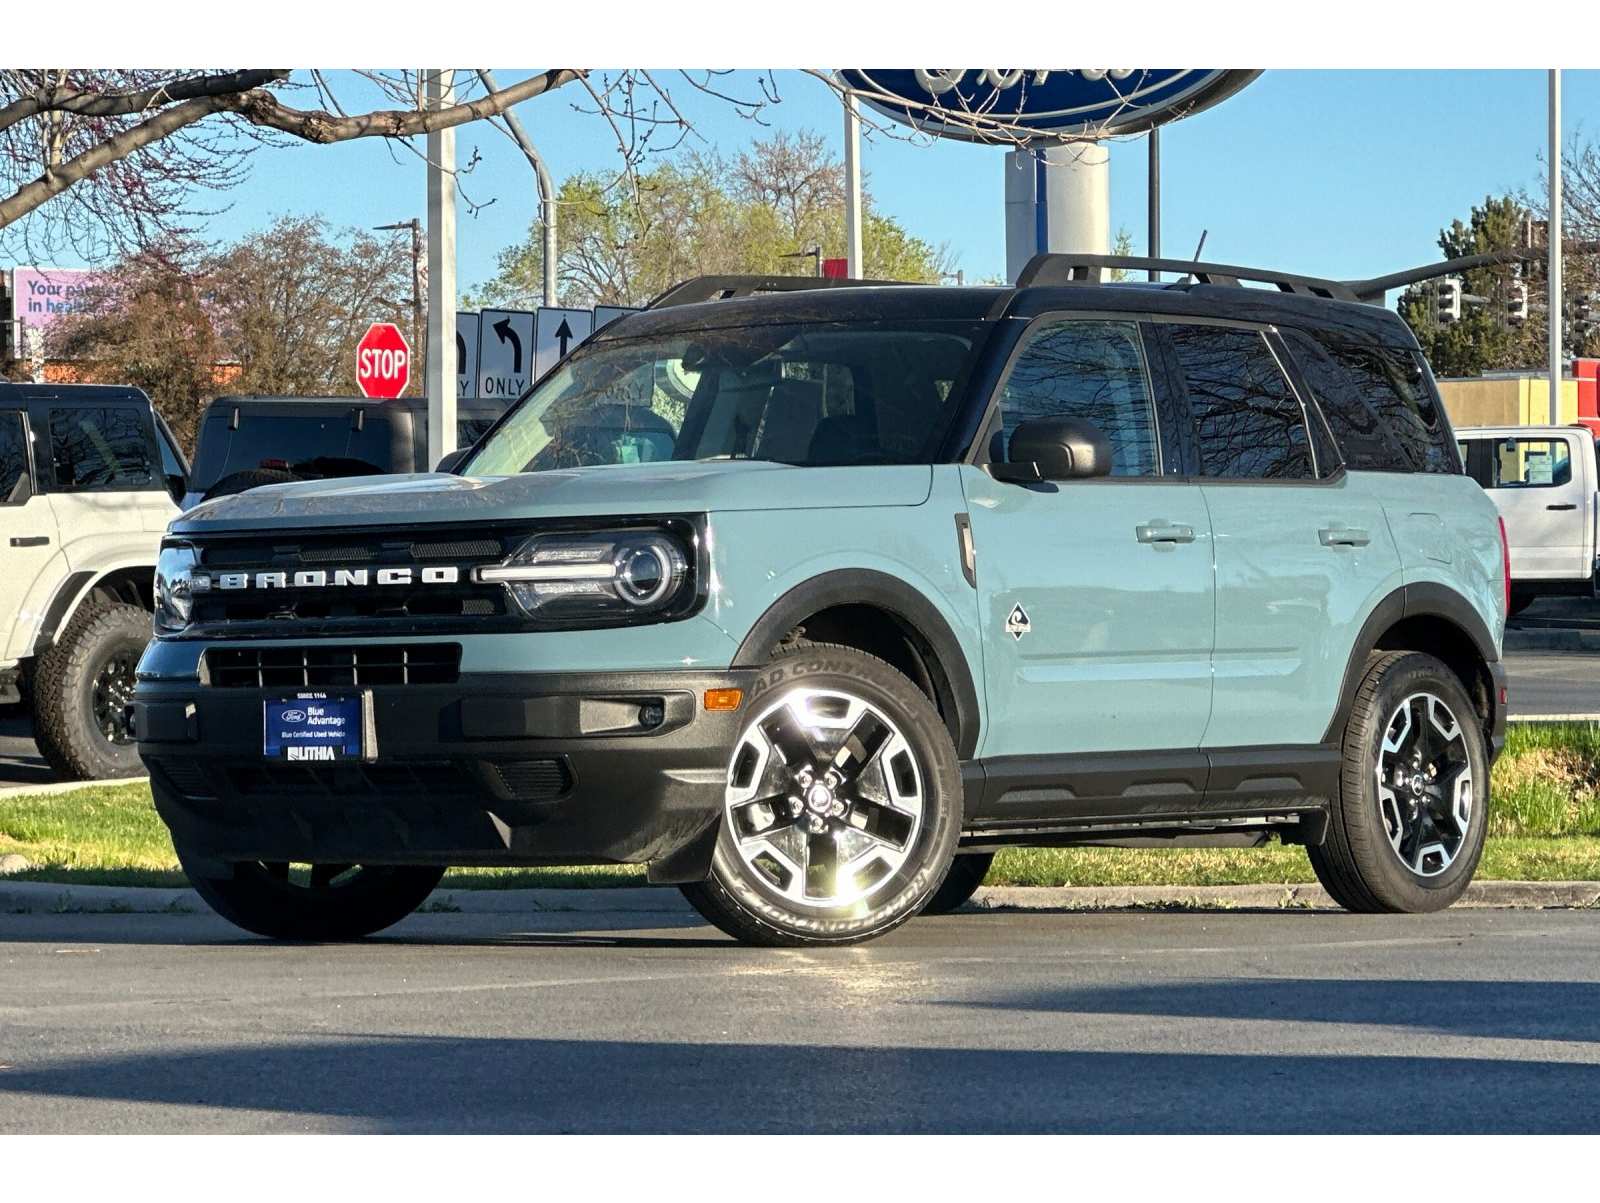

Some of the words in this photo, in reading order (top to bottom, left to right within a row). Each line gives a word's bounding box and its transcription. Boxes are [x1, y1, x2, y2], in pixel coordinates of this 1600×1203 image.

[28, 280, 62, 296] Your
[28, 297, 42, 313] in
[360, 348, 406, 379] STOP
[485, 376, 525, 397] ONLY
[219, 566, 459, 590] BRONCO
[307, 706, 325, 716] Blue
[307, 716, 345, 727] Advantage
